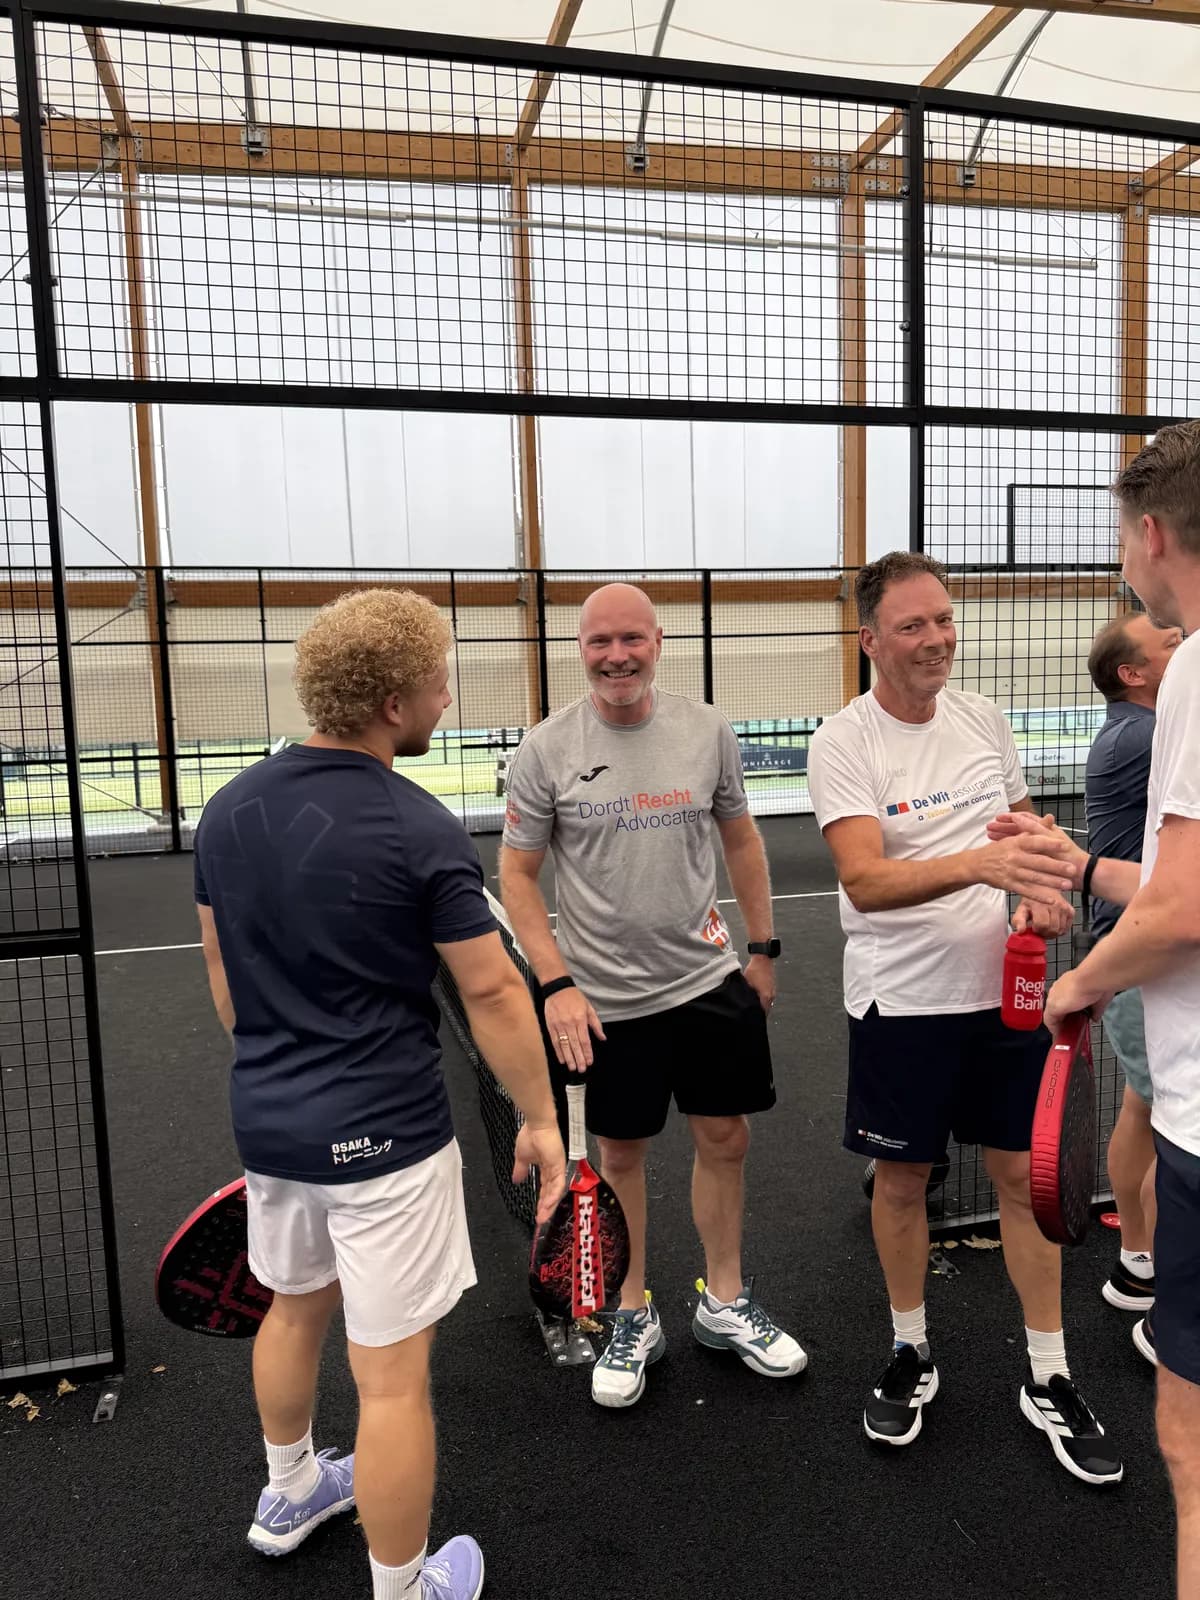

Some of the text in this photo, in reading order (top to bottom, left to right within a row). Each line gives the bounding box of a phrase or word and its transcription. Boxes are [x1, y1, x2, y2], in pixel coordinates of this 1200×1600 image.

[912, 798, 929, 810] De
[928, 791, 950, 805] Wit
[952, 801, 969, 811] Hive
[331, 1136, 371, 1153] OSAKA
[333, 1139, 392, 1165] トレーニング
